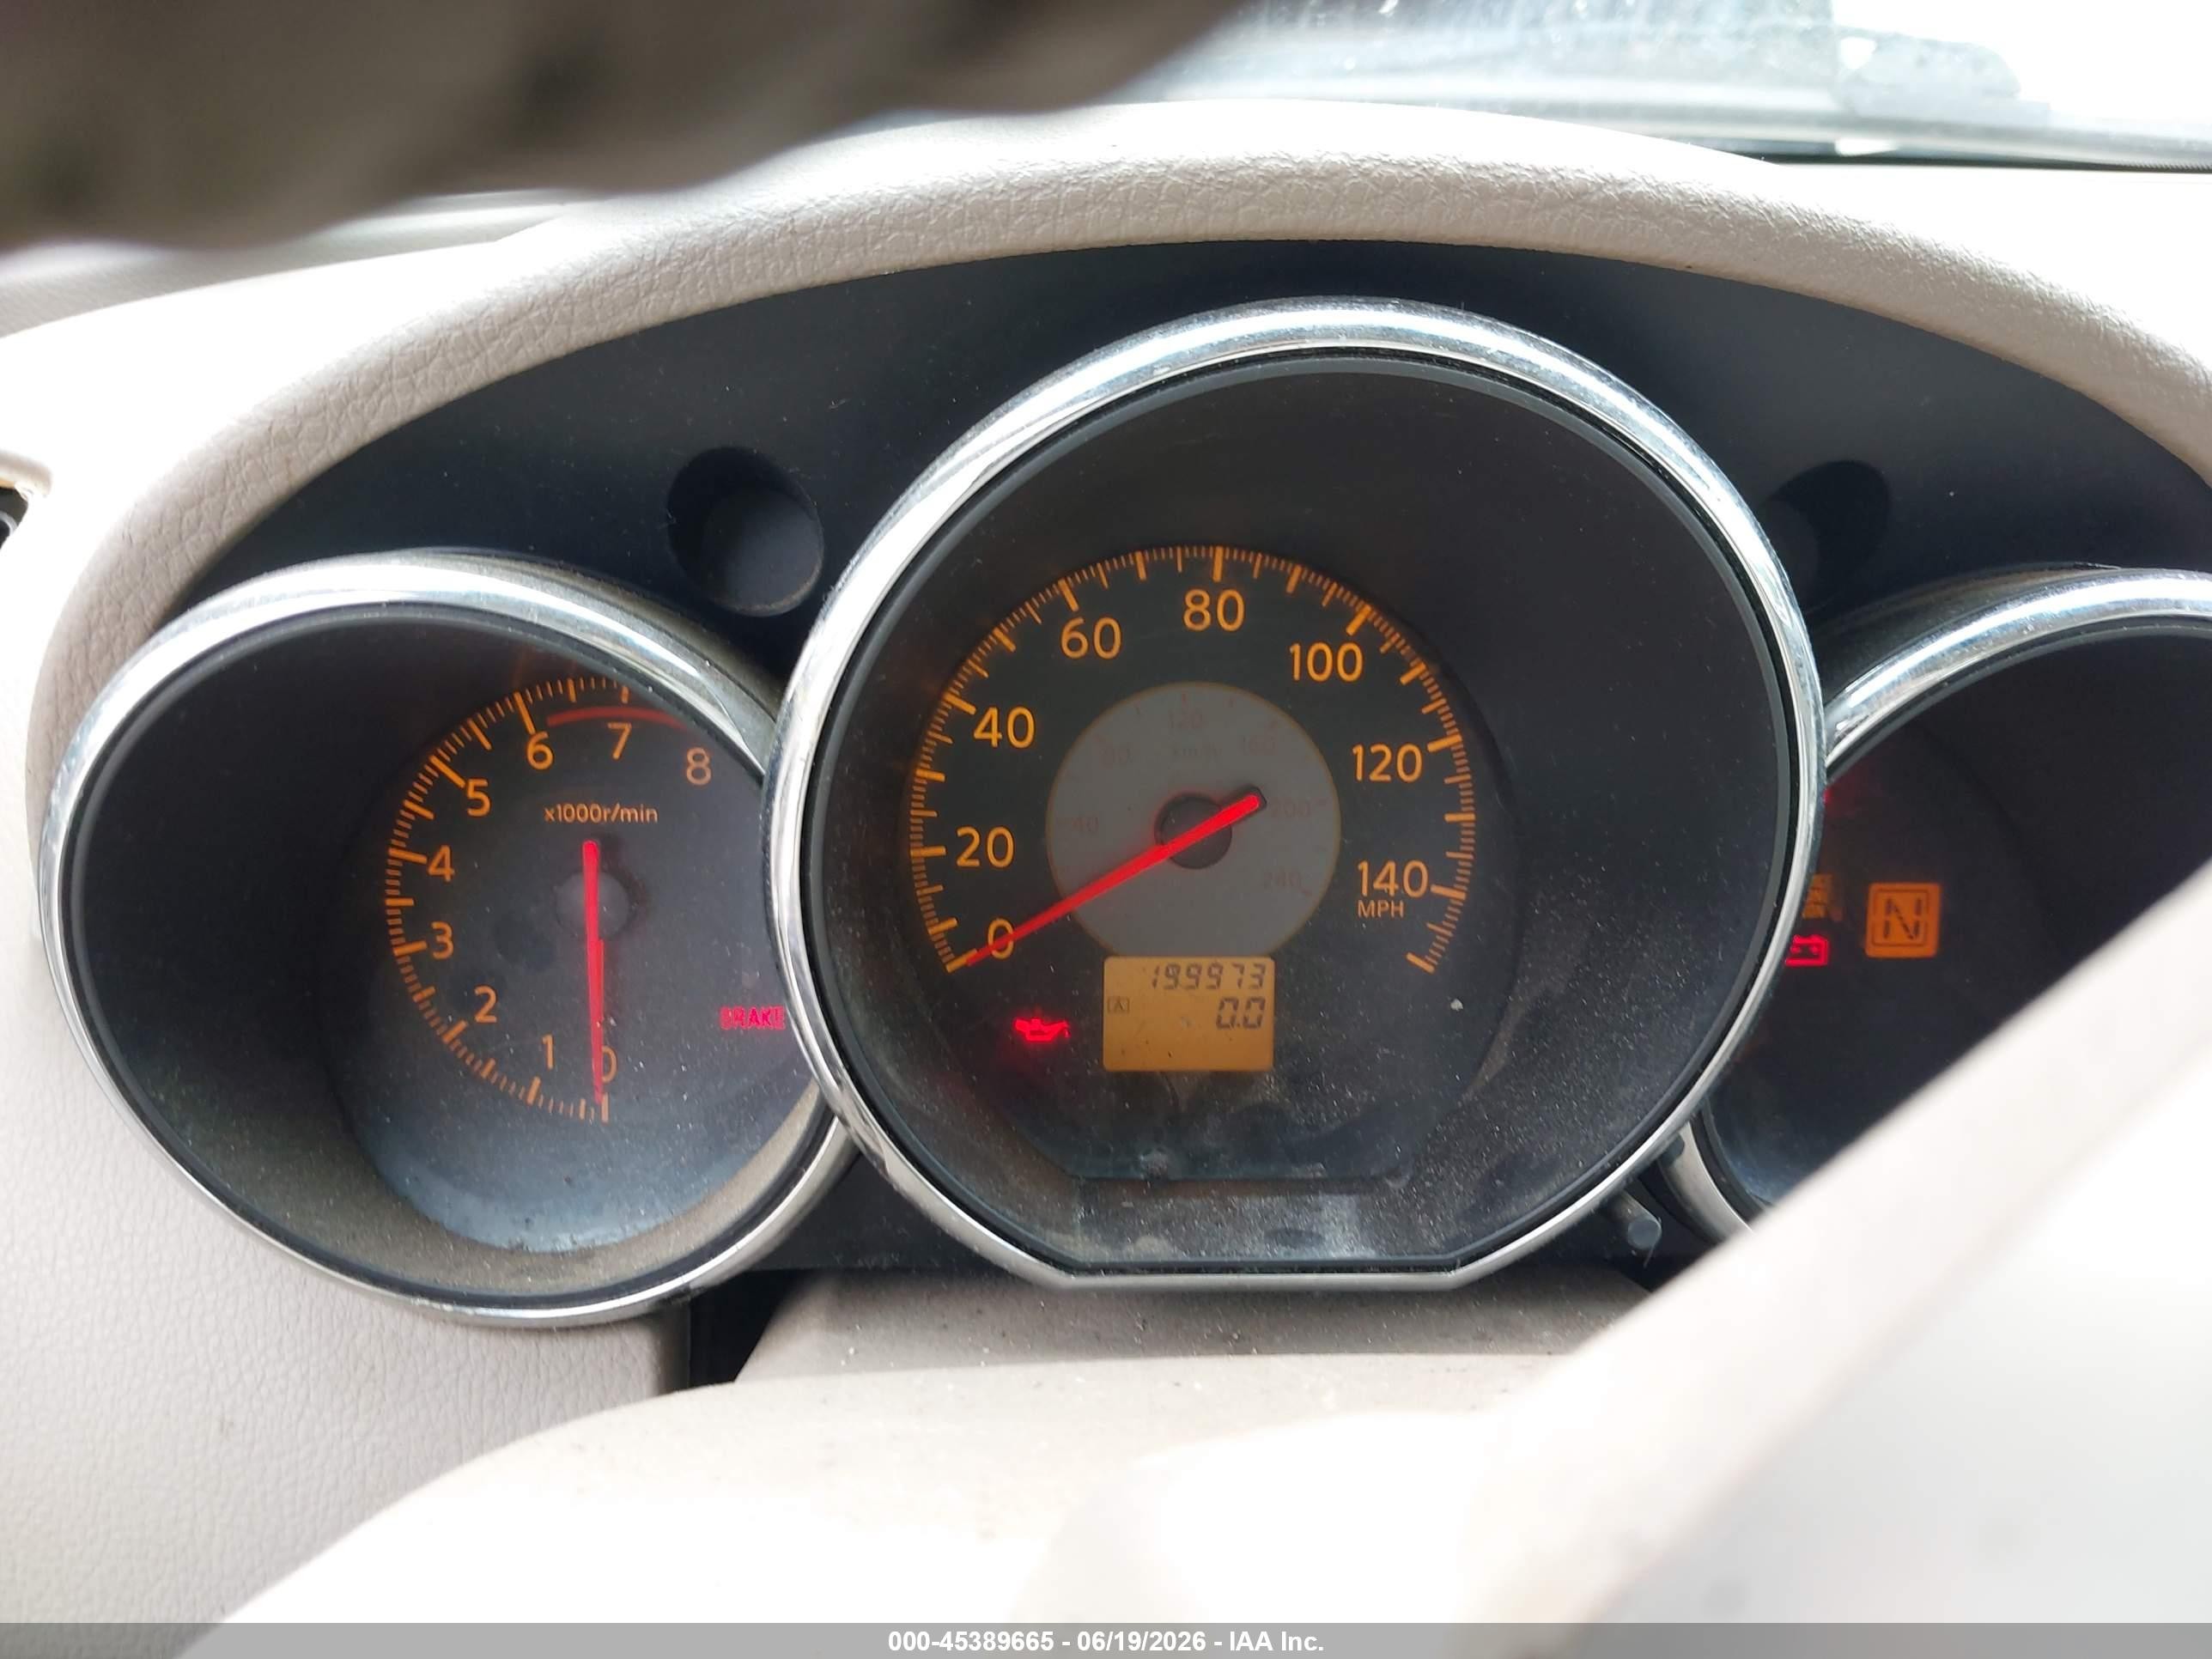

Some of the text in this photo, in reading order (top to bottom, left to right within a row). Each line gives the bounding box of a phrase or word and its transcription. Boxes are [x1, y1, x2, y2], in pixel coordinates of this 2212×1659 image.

[1182, 590, 1245, 631] 80
[1061, 617, 1121, 659] 60
[1290, 642, 1363, 684] 100
[608, 722, 632, 760] 7
[973, 708, 1035, 749] 40
[526, 731, 554, 769] 6
[686, 748, 712, 786] 8
[1352, 744, 1422, 782] 120
[466, 779, 490, 816] 5
[544, 804, 658, 823] x1000r/min
[428, 845, 454, 882] 4
[956, 827, 1015, 868] 20
[1358, 861, 1429, 897] 140
[1358, 902, 1405, 918] MPH
[1883, 898, 1922, 939] N
[432, 922, 453, 959] 3
[988, 919, 1015, 959] 0
[1152, 963, 1267, 989] 199973
[475, 986, 498, 1023] 2
[720, 1006, 787, 1030] BRAKE
[1216, 997, 1267, 1029] 0.0
[542, 1035, 554, 1069] 1
